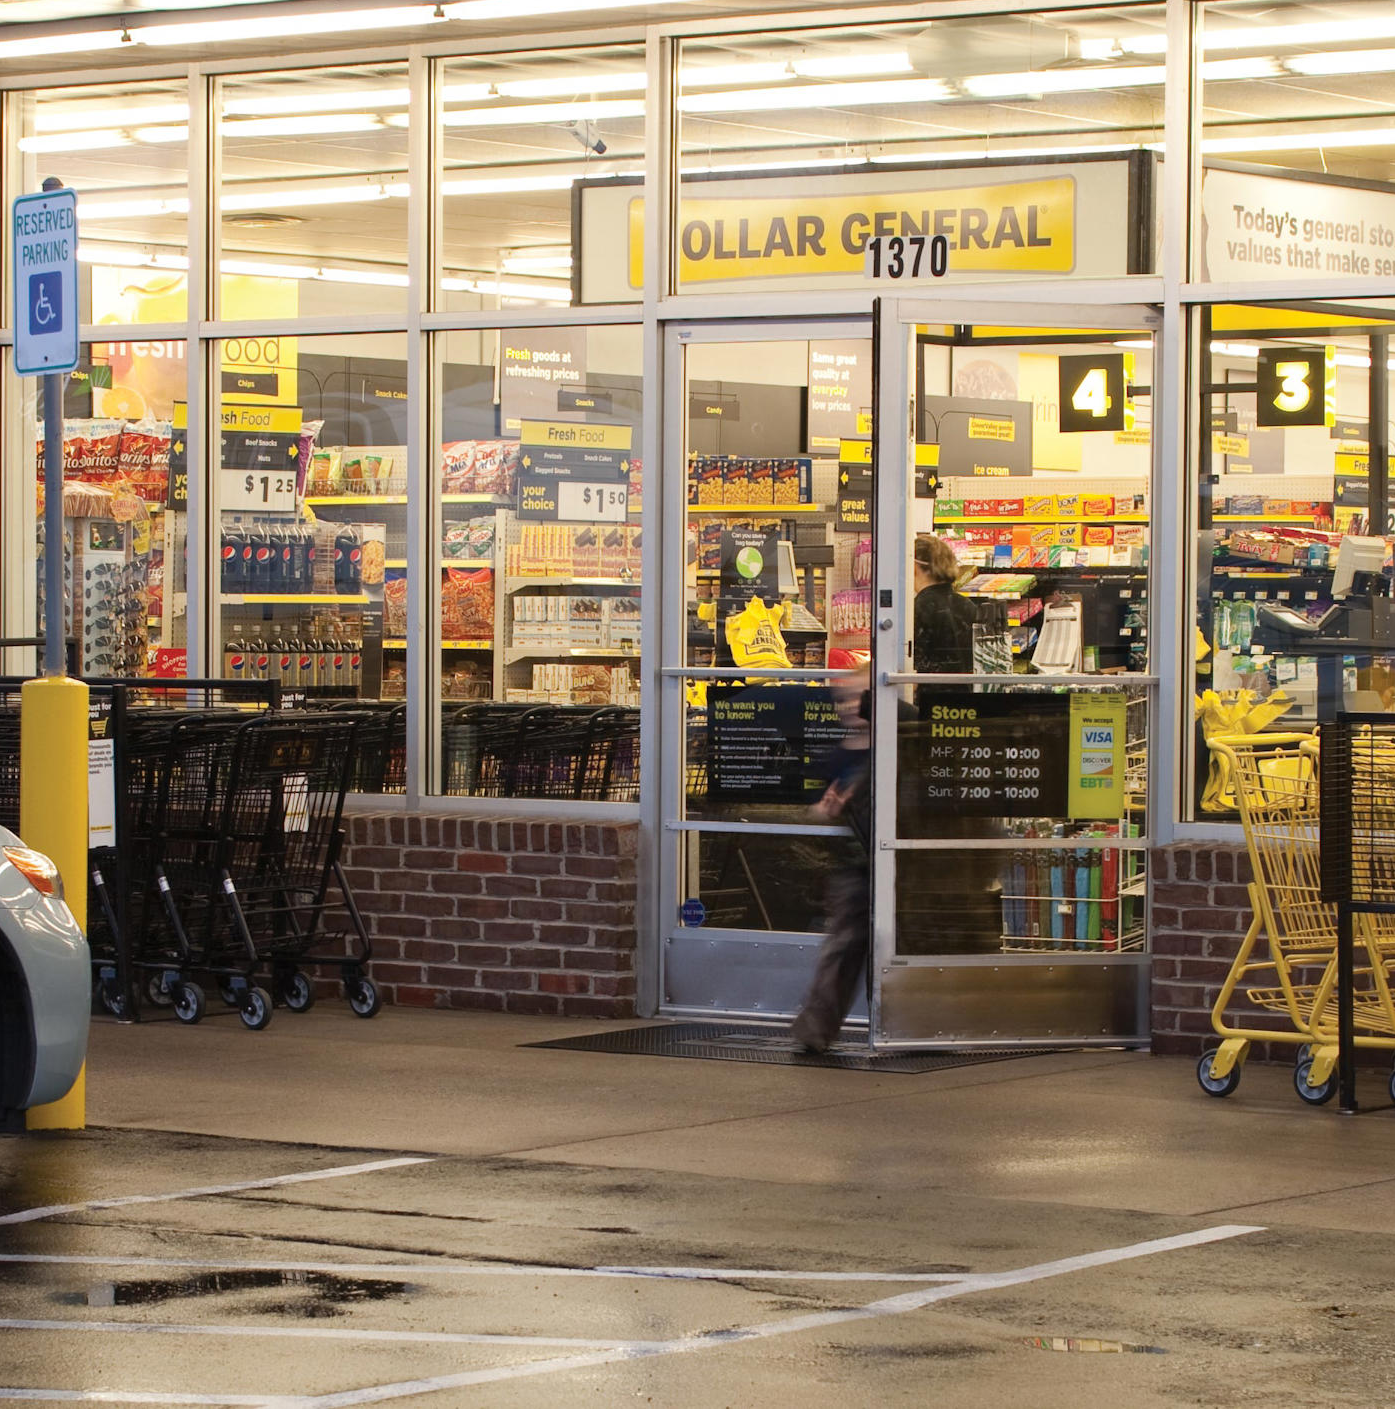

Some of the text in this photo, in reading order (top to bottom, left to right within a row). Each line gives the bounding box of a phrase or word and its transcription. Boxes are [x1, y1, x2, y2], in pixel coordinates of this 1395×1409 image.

[16, 207, 74, 237] RESERVED
[1232, 204, 1298, 239] Today's
[1303, 217, 1364, 242] general
[681, 204, 1052, 261] OLLAR GENERAL
[22, 239, 69, 267] PARKING
[868, 235, 948, 279] 1370
[1227, 238, 1282, 266] values
[1286, 243, 1322, 270] that
[1325, 249, 1371, 277] make
[225, 337, 281, 365] ood
[505, 347, 572, 364] Fresh goods at
[812, 352, 858, 367] Same great
[505, 366, 580, 383] refreshing prices
[812, 370, 851, 382] quality at
[811, 385, 849, 398] everyday
[1072, 368, 1112, 418] 4
[1272, 361, 1311, 412] 3
[706, 406, 723, 416] Candy
[812, 401, 852, 413] low prices
[240, 411, 271, 426] Food
[548, 427, 605, 442] Fresh Food
[64, 456, 84, 469] itos
[120, 451, 151, 466] oritos
[1354, 459, 1370, 472] Fres
[522, 485, 546, 498] your
[522, 497, 555, 511] choice
[841, 499, 866, 512] great
[841, 511, 870, 524] values
[281, 693, 305, 702] Just for
[101, 703, 112, 711] for
[281, 701, 293, 709] you
[714, 701, 775, 711] We want you
[714, 710, 755, 720] to know:
[804, 711, 842, 722] for you.
[931, 705, 977, 721] Store
[931, 723, 982, 739] Hours
[1085, 732, 1113, 743] VISA
[930, 746, 1041, 760] M-F: 7:00 10:00
[930, 766, 1040, 779] Sat: 7:00 10:00
[1080, 777, 1104, 788] EBT
[928, 785, 1040, 799] Sun: 7:00 10:00
